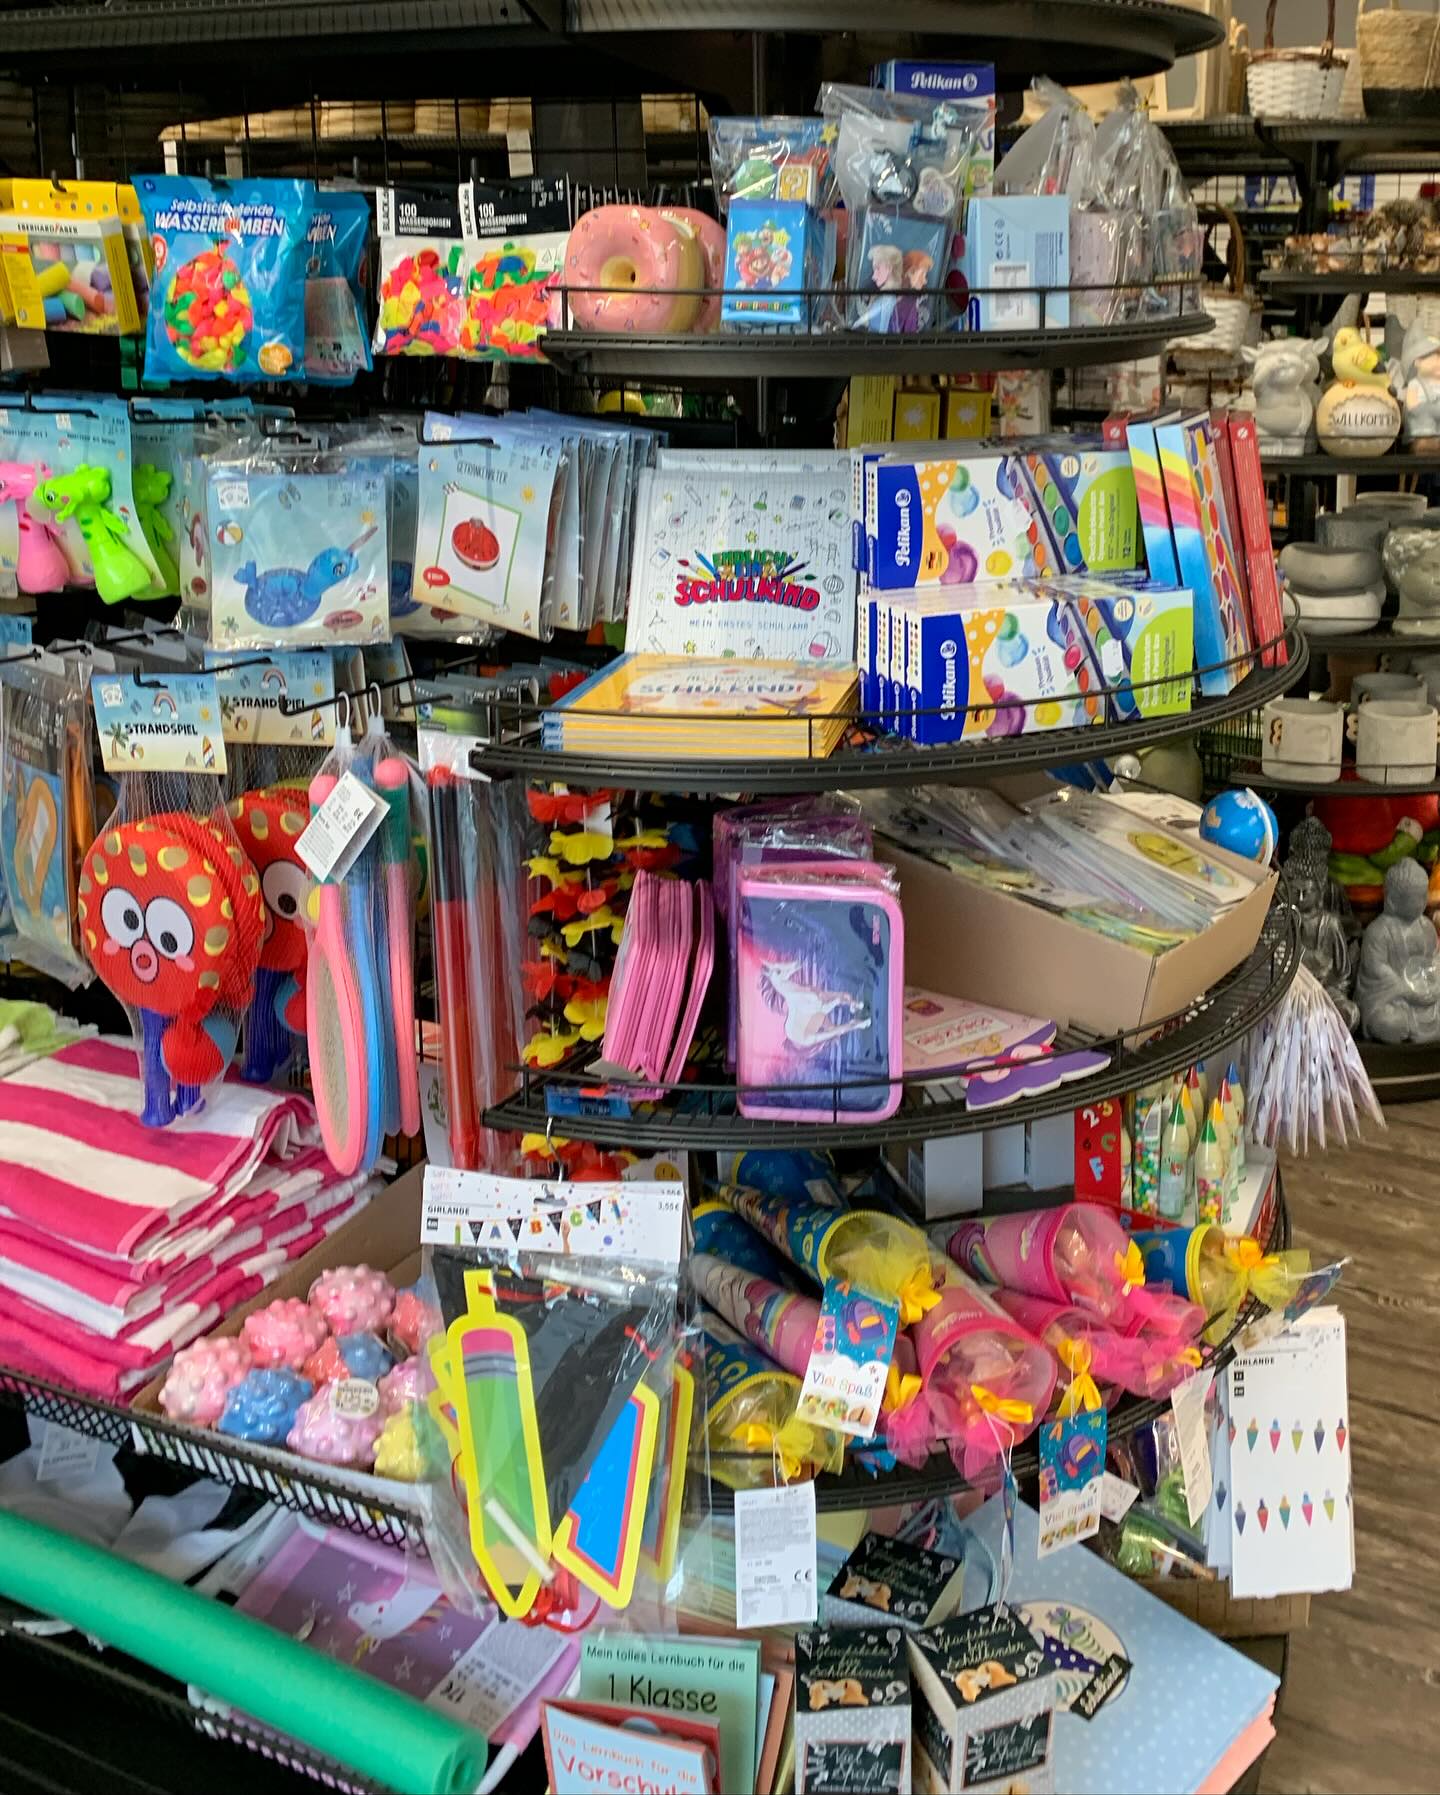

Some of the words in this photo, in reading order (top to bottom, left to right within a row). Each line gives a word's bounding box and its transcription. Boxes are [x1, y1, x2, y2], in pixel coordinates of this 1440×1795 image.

[911, 71, 962, 90] Pelikan
[399, 203, 417, 218] 100
[478, 203, 495, 218] 100
[895, 506, 911, 567] Pelikan
[674, 575, 821, 612] SCHULKIND
[125, 722, 198, 736] STRANDSPIEL
[427, 1205, 470, 1216] GIRLANDE
[1233, 1357, 1275, 1367] GIRLANDE
[813, 1370, 836, 1386] Viel
[587, 1645, 613, 1659] Mein
[616, 1649, 647, 1663] tolles
[651, 1652, 705, 1668] Lernbuch
[708, 1658, 724, 1670] für
[728, 1660, 746, 1672] die
[630, 1674, 718, 1714] Klasse
[553, 1727, 576, 1747] Das
[583, 1739, 644, 1768] Lernbuch
[678, 1769, 697, 1784] die
[558, 1747, 694, 1795] Vorschul
